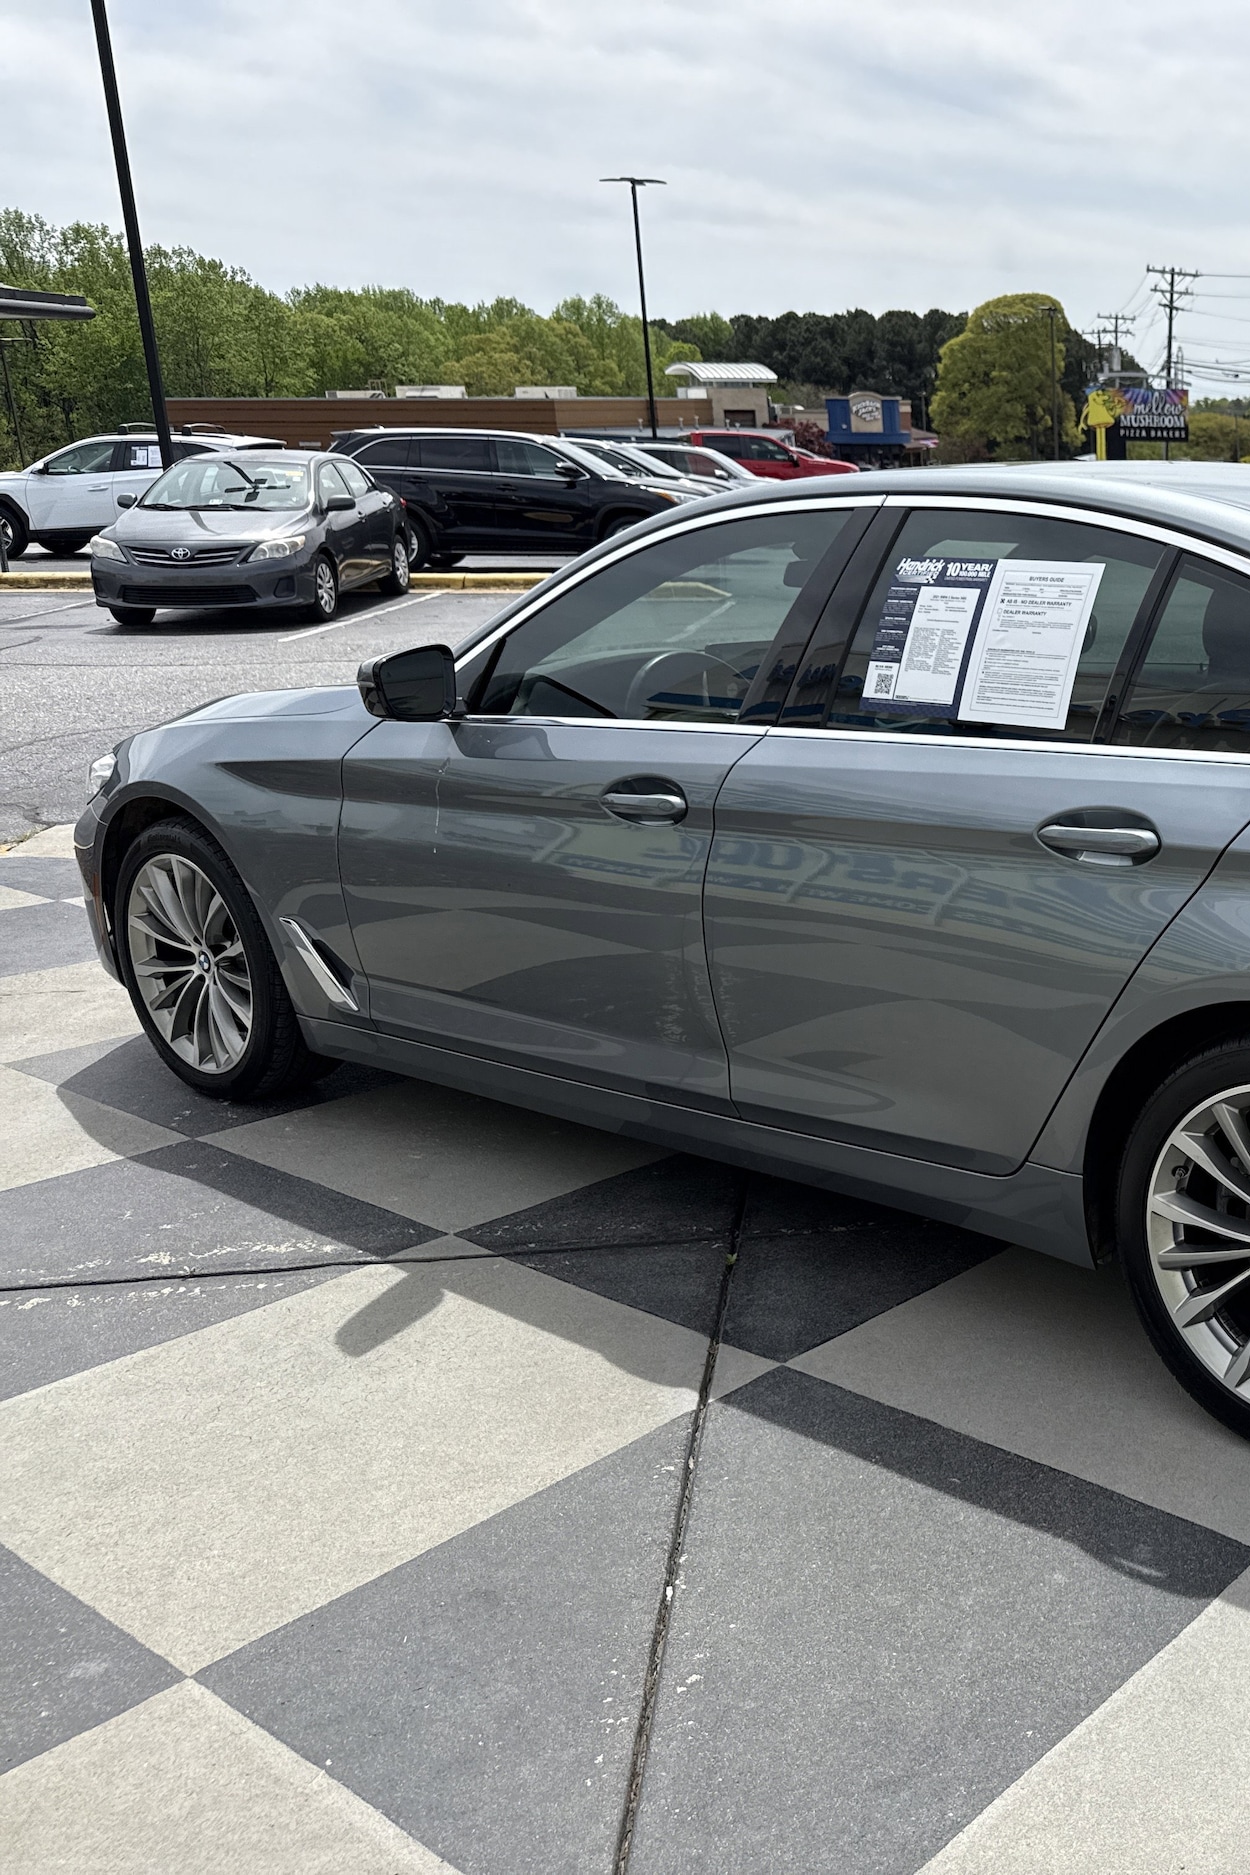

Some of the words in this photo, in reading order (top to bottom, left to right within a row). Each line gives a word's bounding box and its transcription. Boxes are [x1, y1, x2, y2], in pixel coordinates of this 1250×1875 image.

[1134, 391, 1184, 415] mellow
[1120, 415, 1185, 428] MUSHROOM
[1120, 428, 1147, 438] PIZZA
[1150, 429, 1186, 439] BAKERS
[896, 558, 945, 575] Hendrick
[946, 562, 961, 576] 10
